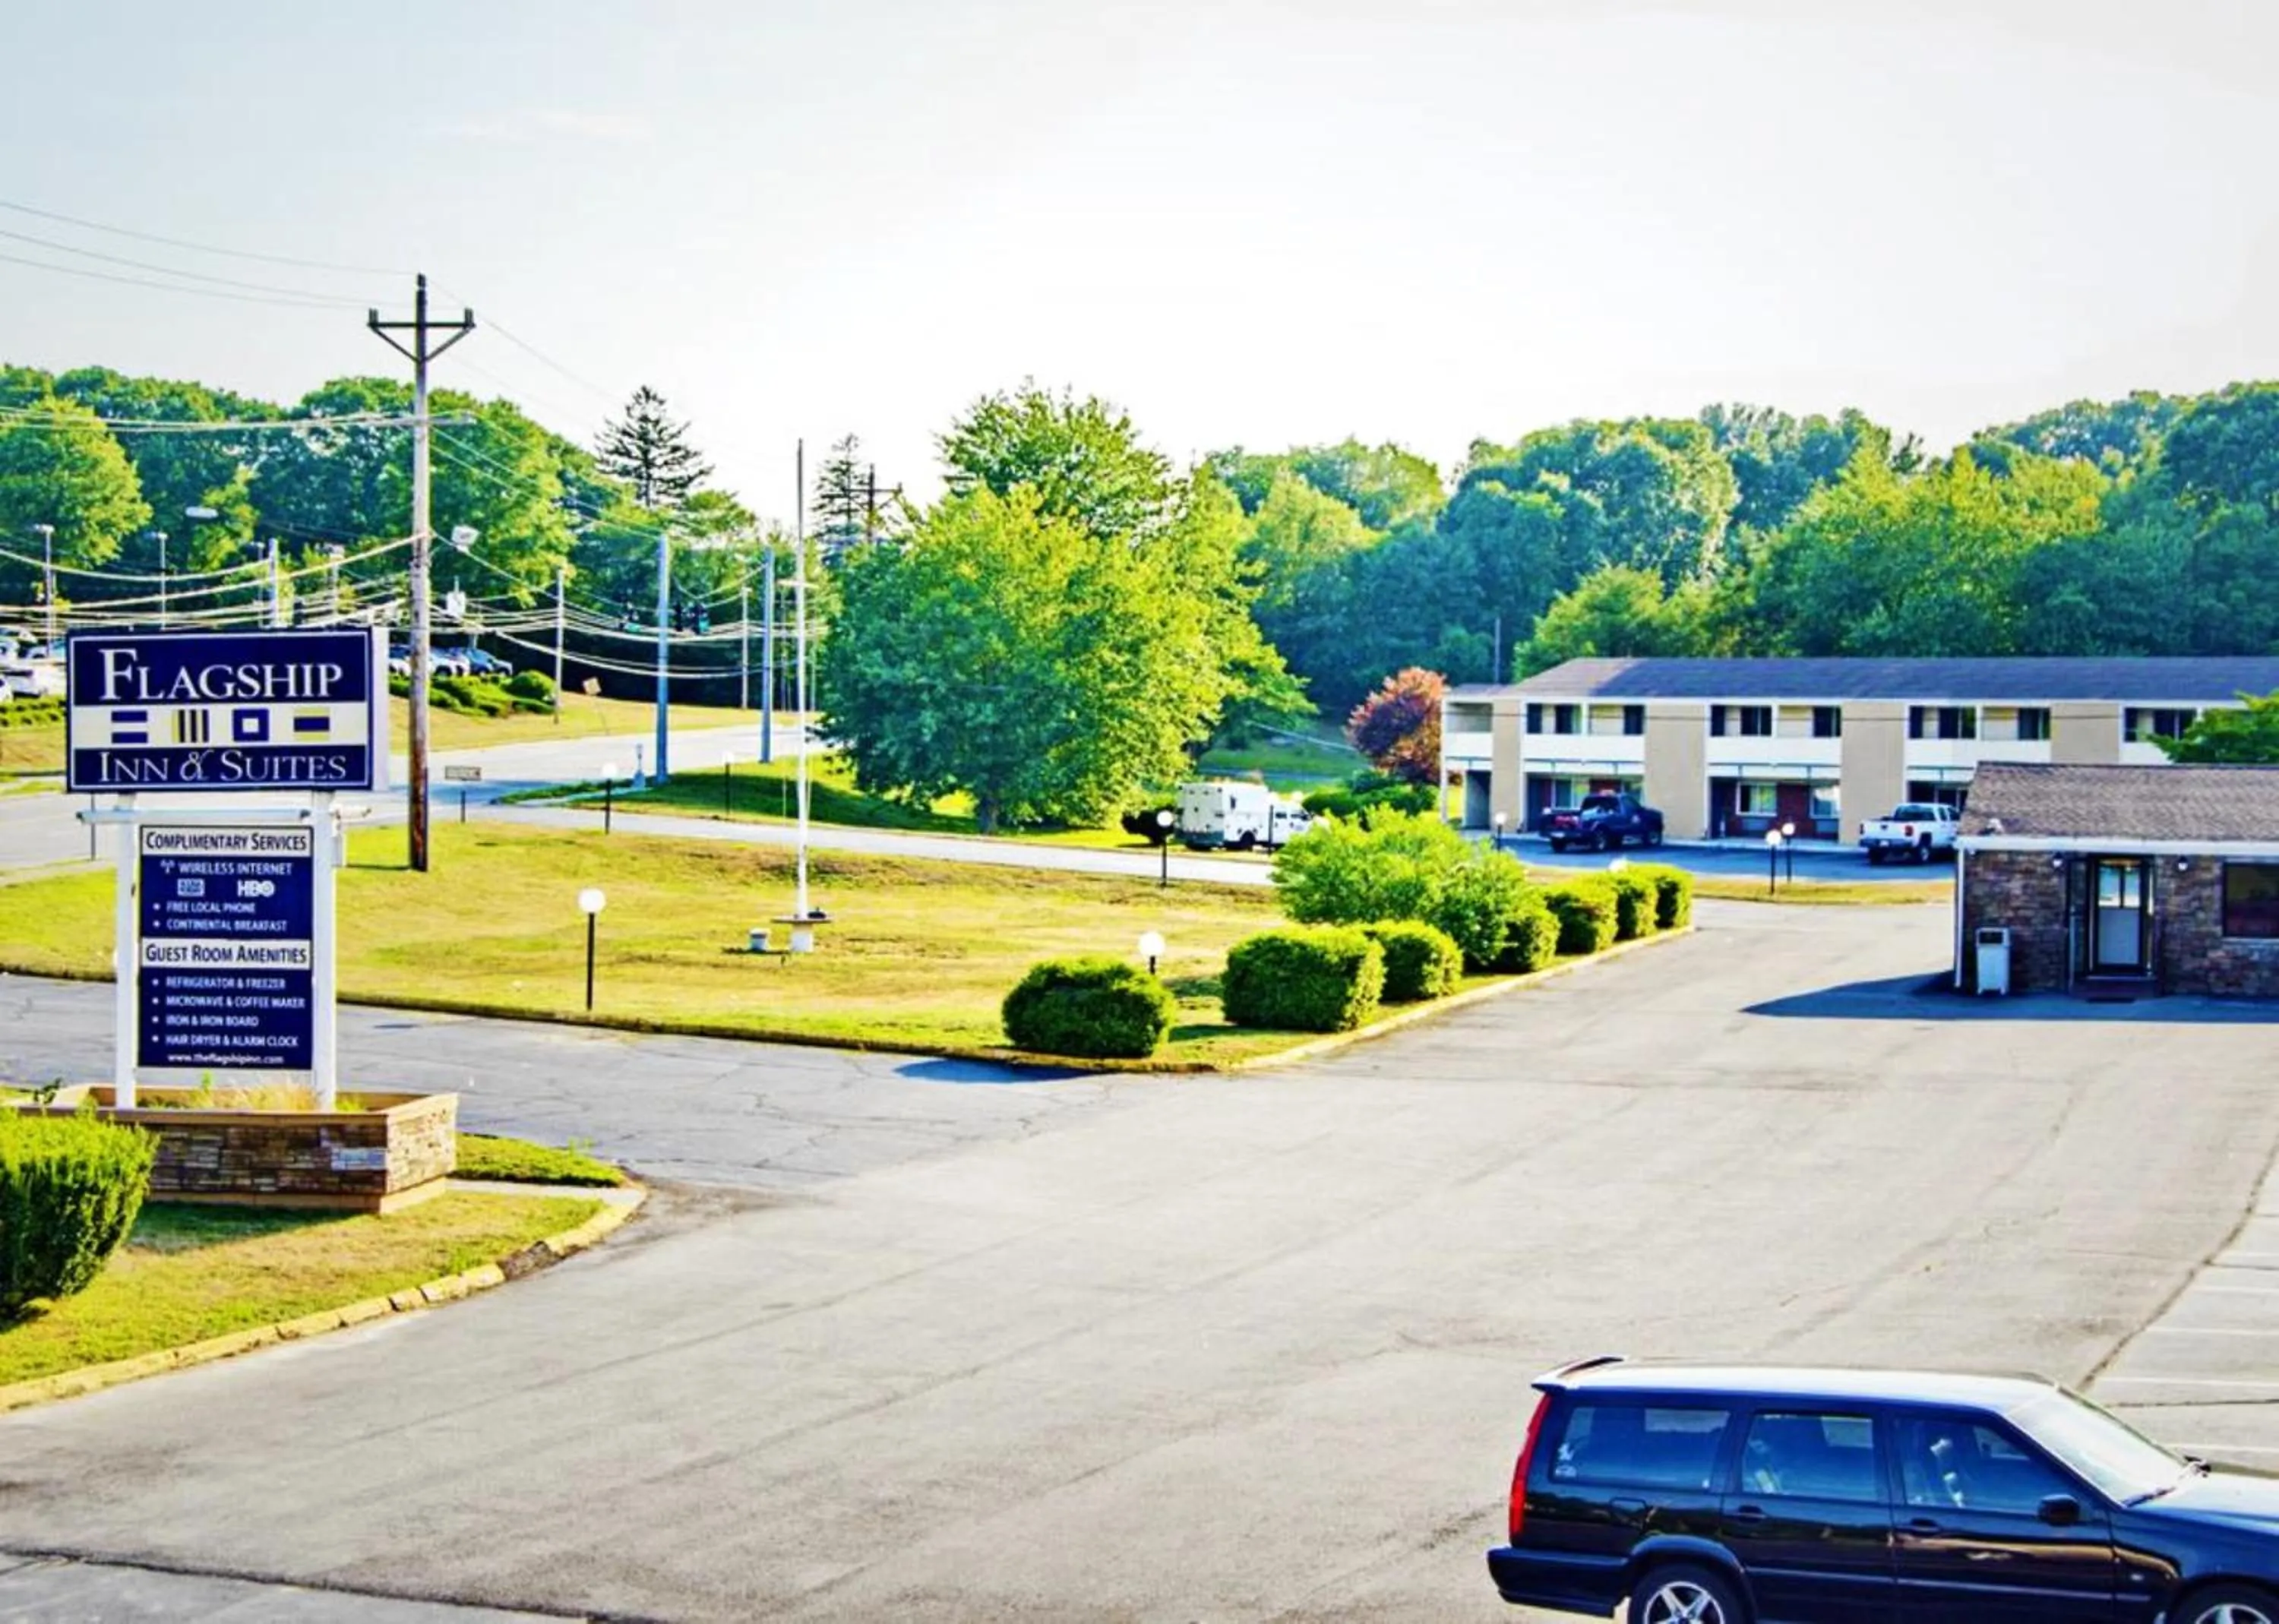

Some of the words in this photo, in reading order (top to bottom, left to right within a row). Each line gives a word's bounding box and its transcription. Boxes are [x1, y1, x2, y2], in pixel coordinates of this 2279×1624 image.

[100, 751, 169, 782] INN
[180, 750, 213, 781] &
[220, 750, 346, 781] SUITES
[146, 832, 248, 850] COMPLIMENTARY
[251, 833, 307, 851] SERVICES
[179, 862, 234, 874] WIRELESS
[237, 862, 292, 874] INTERNET
[237, 880, 275, 897] HBO
[166, 902, 189, 912] FREE
[191, 902, 221, 912] LOCAL
[223, 902, 255, 913] PHONE
[166, 918, 231, 930] CONTINENTAL
[235, 919, 287, 931] BREAKFAST
[146, 944, 187, 962] GUEST
[191, 944, 232, 962] ROOM
[236, 946, 306, 963] AMENITIES
[166, 976, 235, 988] REFRIGERATOR
[246, 978, 286, 989] FREEZER
[166, 996, 223, 1006] MICROWAVE
[235, 997, 269, 1007] COFFEE
[271, 997, 305, 1008] MAKER
[166, 1015, 189, 1026] IRON
[226, 1016, 259, 1027] BOARD
[166, 1034, 189, 1046] HAIR
[191, 1035, 220, 1046] DRYER
[232, 1035, 264, 1047] ALARM
[267, 1036, 298, 1047] CLOCK
